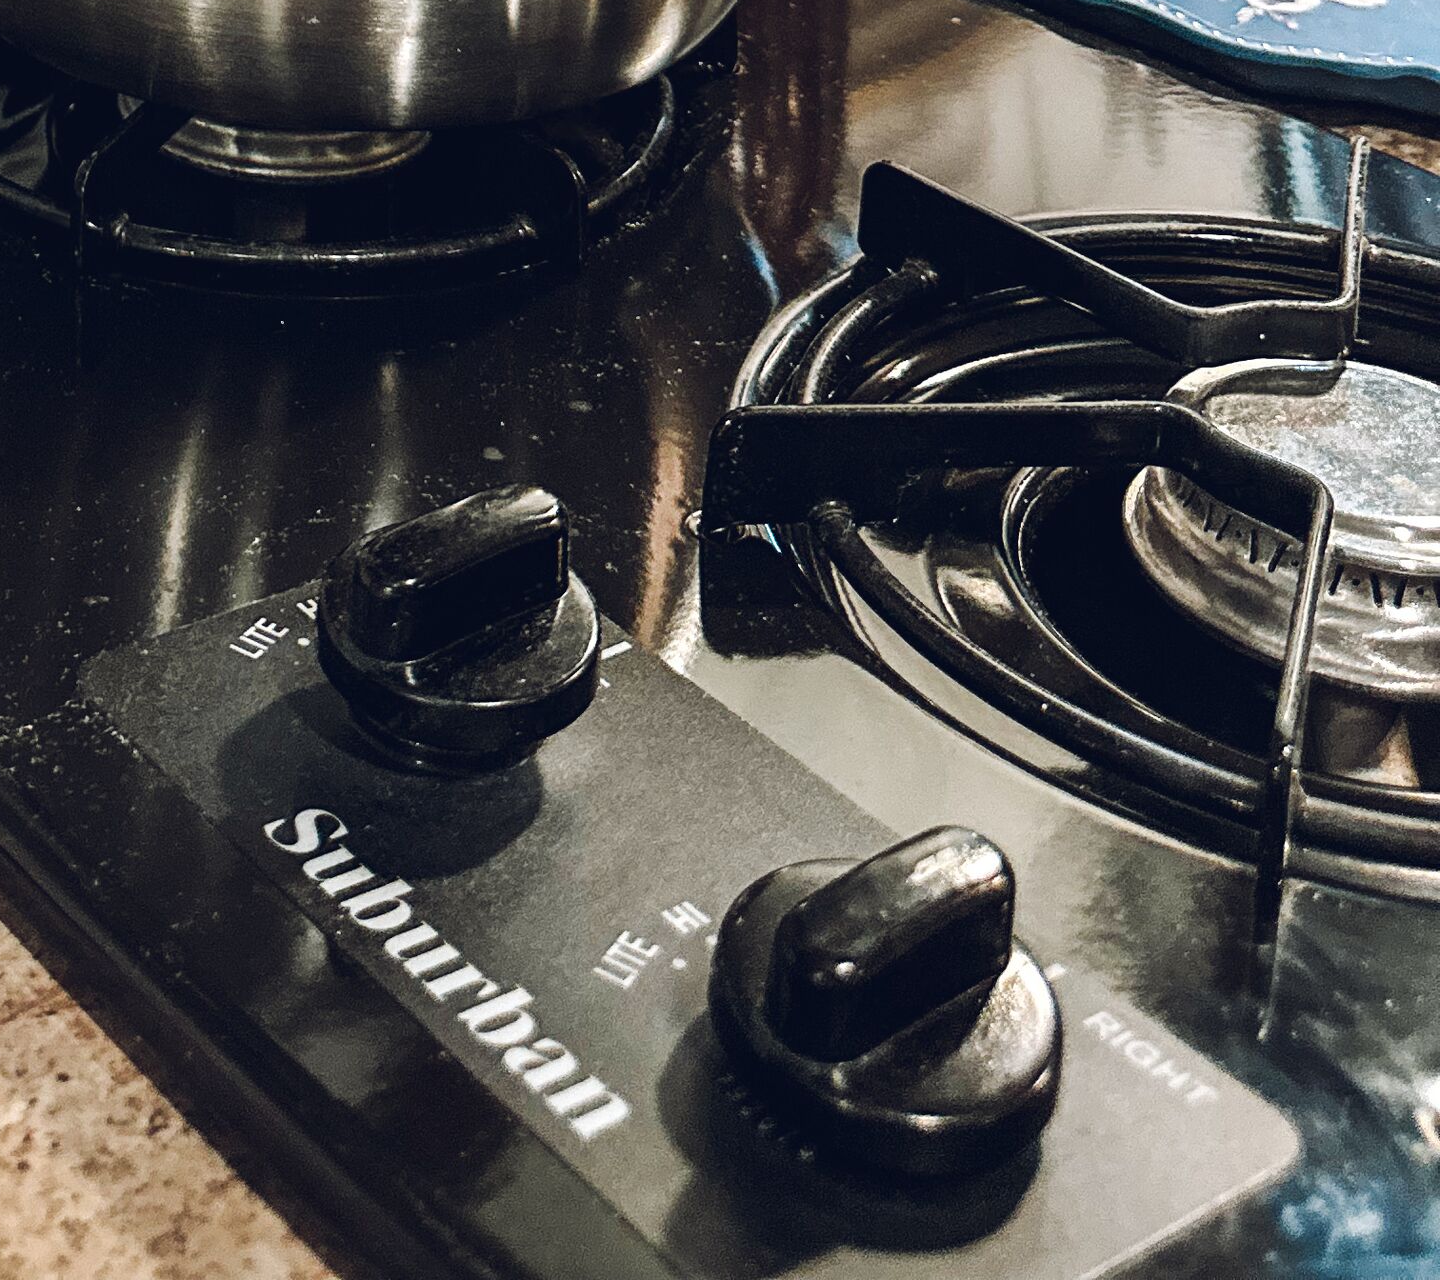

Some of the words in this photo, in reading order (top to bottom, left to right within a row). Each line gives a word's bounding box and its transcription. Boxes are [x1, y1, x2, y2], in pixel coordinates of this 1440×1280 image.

[229, 617, 290, 659] LITE
[661, 901, 712, 934] HI
[264, 807, 632, 1141] Suburban
[593, 930, 660, 989] LITE
[1082, 1011, 1218, 1106] RIGHT
